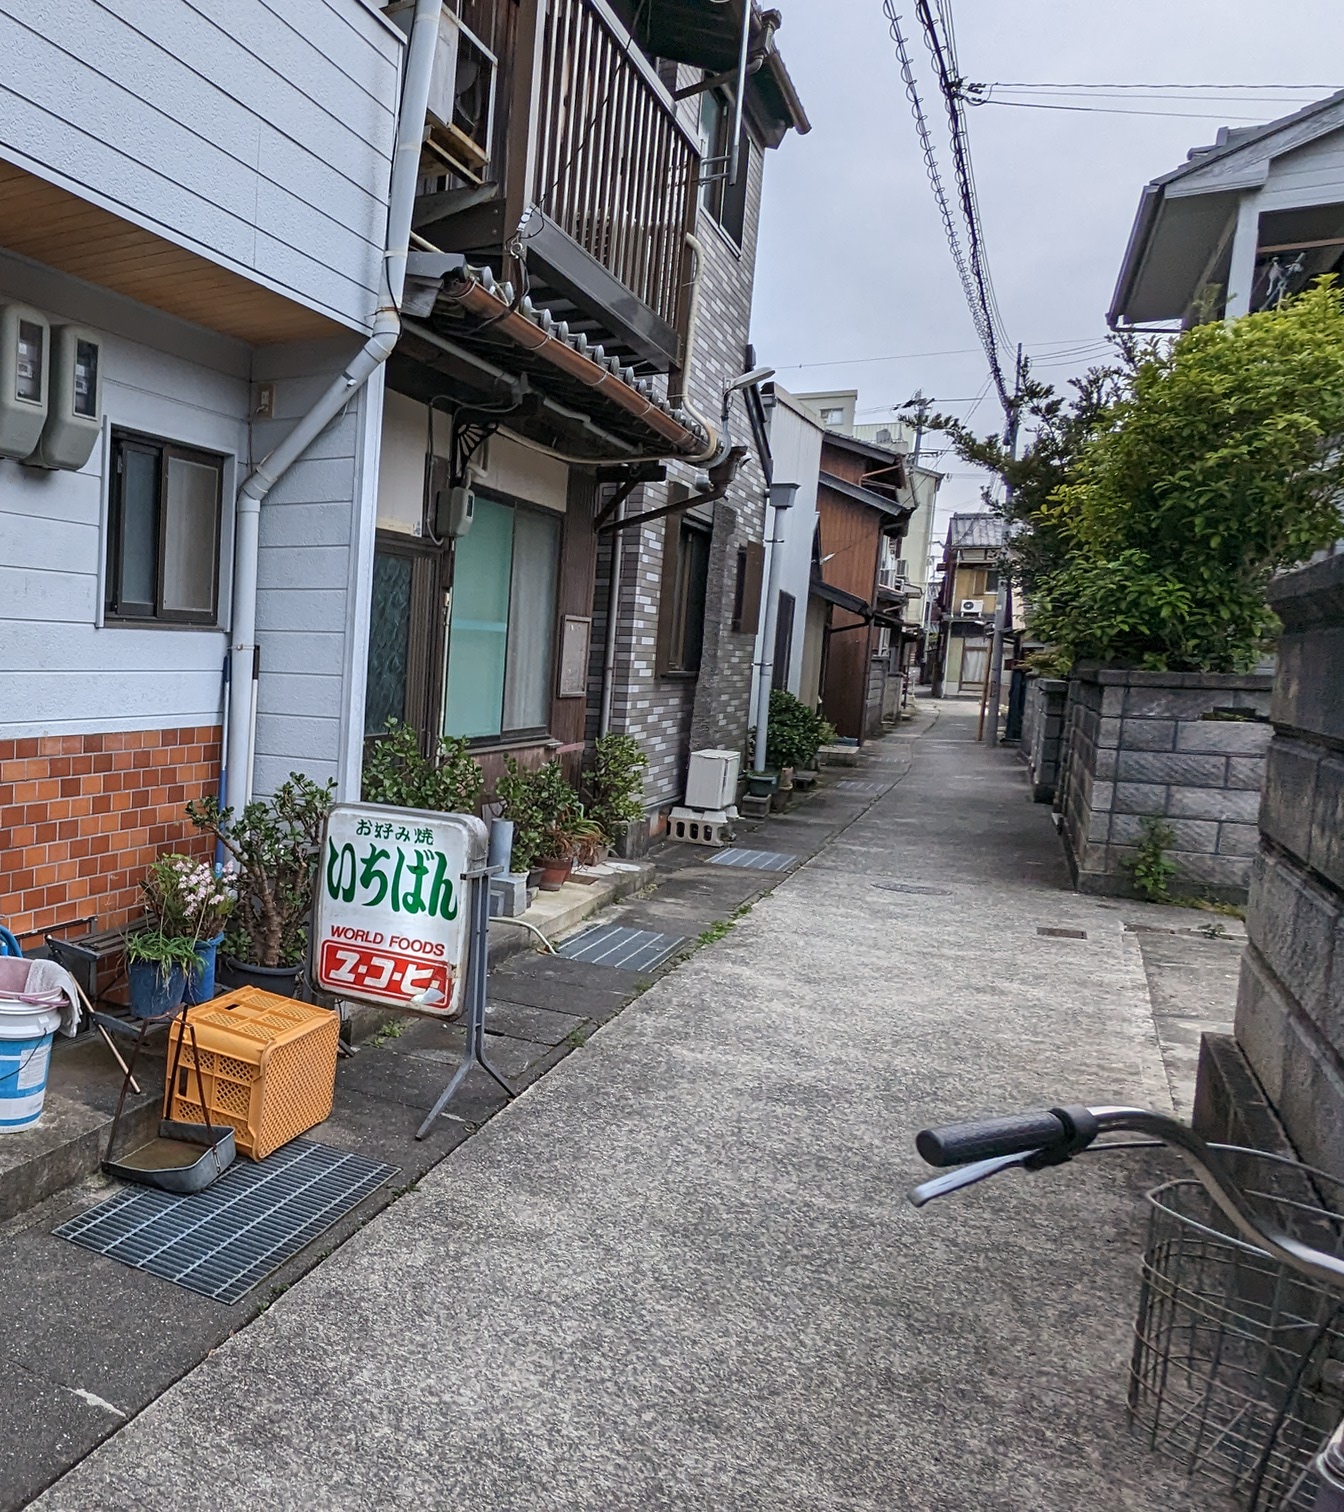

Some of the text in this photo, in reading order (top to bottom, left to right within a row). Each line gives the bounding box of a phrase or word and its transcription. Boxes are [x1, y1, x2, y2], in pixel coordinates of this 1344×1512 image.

[356, 819, 434, 845] お好み焼
[327, 836, 458, 921] いちばん
[330, 925, 445, 956] WORLD FOODS
